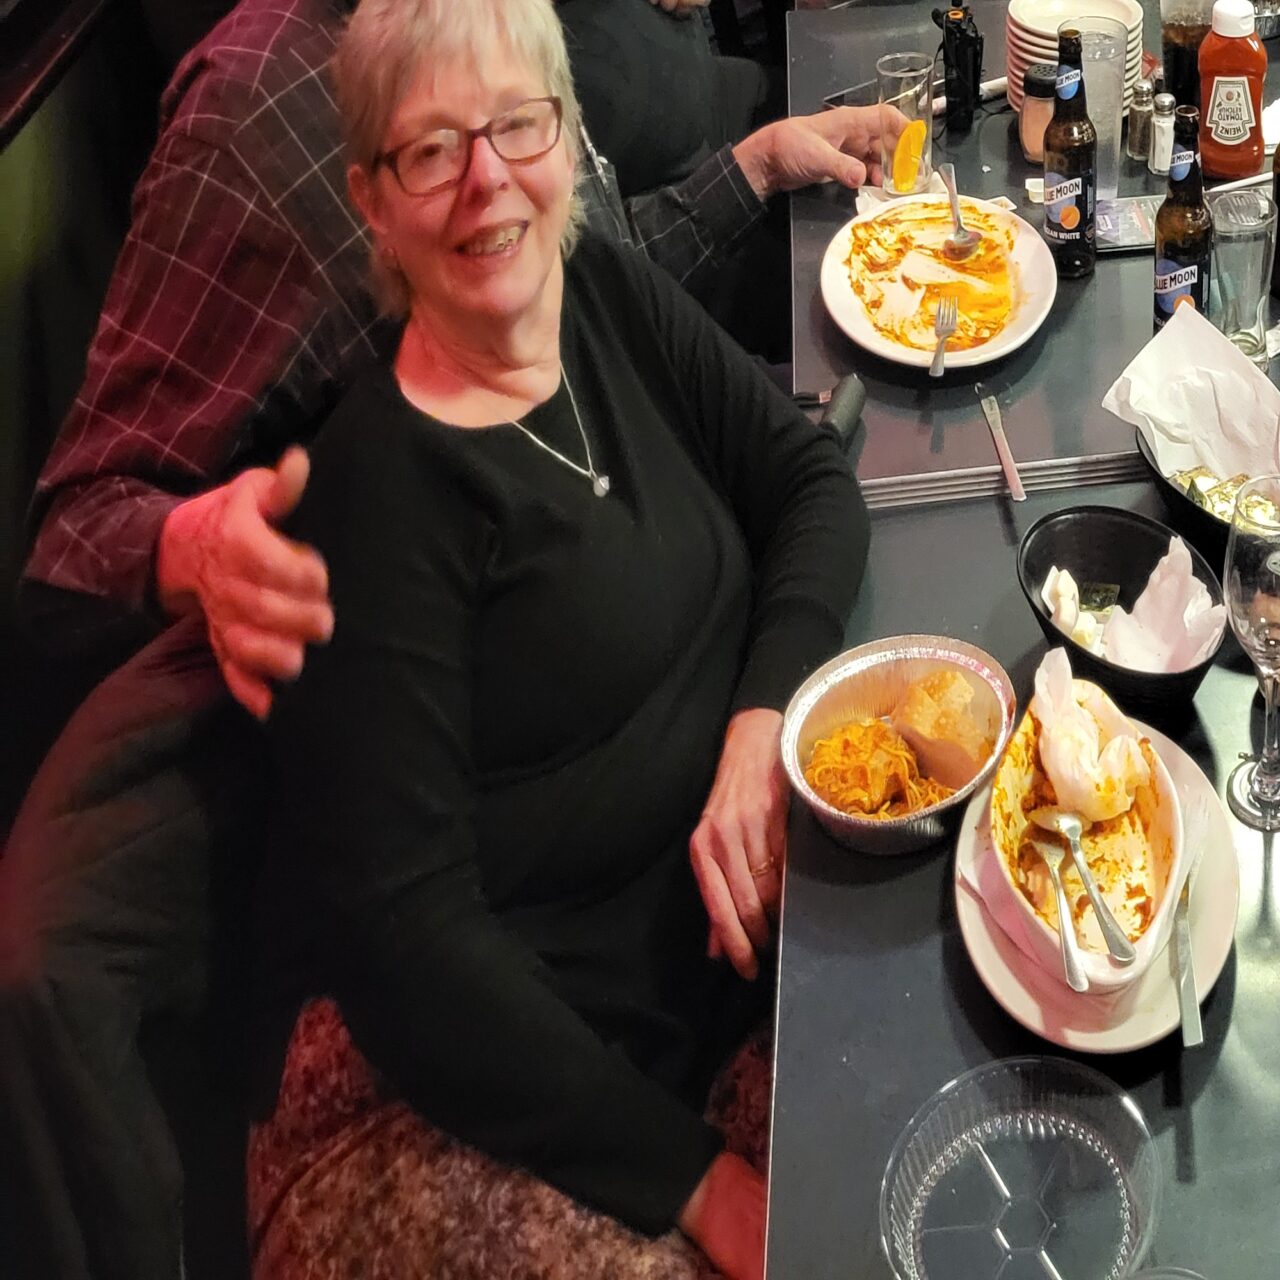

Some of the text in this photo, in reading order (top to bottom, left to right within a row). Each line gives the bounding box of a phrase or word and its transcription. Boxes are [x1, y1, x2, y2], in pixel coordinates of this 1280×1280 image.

[1065, 71, 1080, 83] MOON
[1217, 112, 1243, 121] TOMATO
[1219, 125, 1242, 135] HEINZ
[1176, 154, 1193, 163] MOON
[1056, 181, 1080, 199] MOON
[1059, 231, 1081, 240] WHITE
[1169, 268, 1196, 288] MOON
